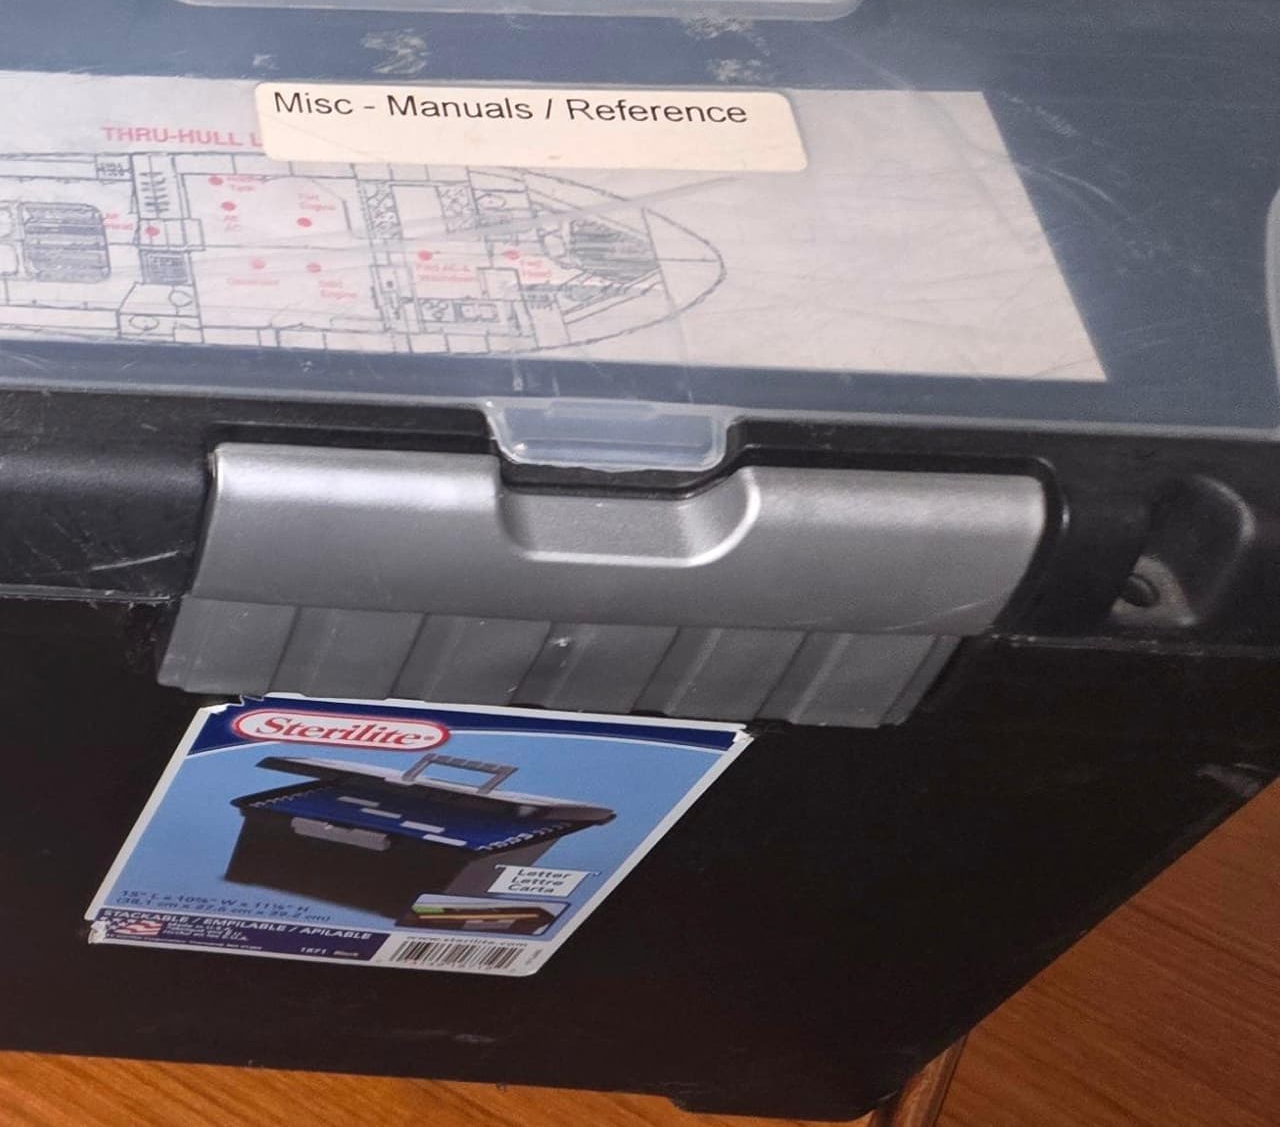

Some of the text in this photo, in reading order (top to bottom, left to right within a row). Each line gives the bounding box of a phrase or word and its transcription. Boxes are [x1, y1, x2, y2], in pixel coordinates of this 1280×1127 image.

[273, 91, 354, 115] Misc
[386, 94, 534, 120] Manuals
[544, 97, 553, 121] /
[566, 98, 748, 123] Reference
[101, 126, 243, 147] THRU-HULL
[518, 868, 572, 879] Letter
[511, 876, 564, 886] Lettre
[508, 883, 555, 893] Carta
[104, 909, 190, 924] STACKABLE
[202, 917, 287, 933] EMPILABLE
[299, 926, 373, 940] APILABLE
[406, 935, 529, 948] www.sterilite.com
